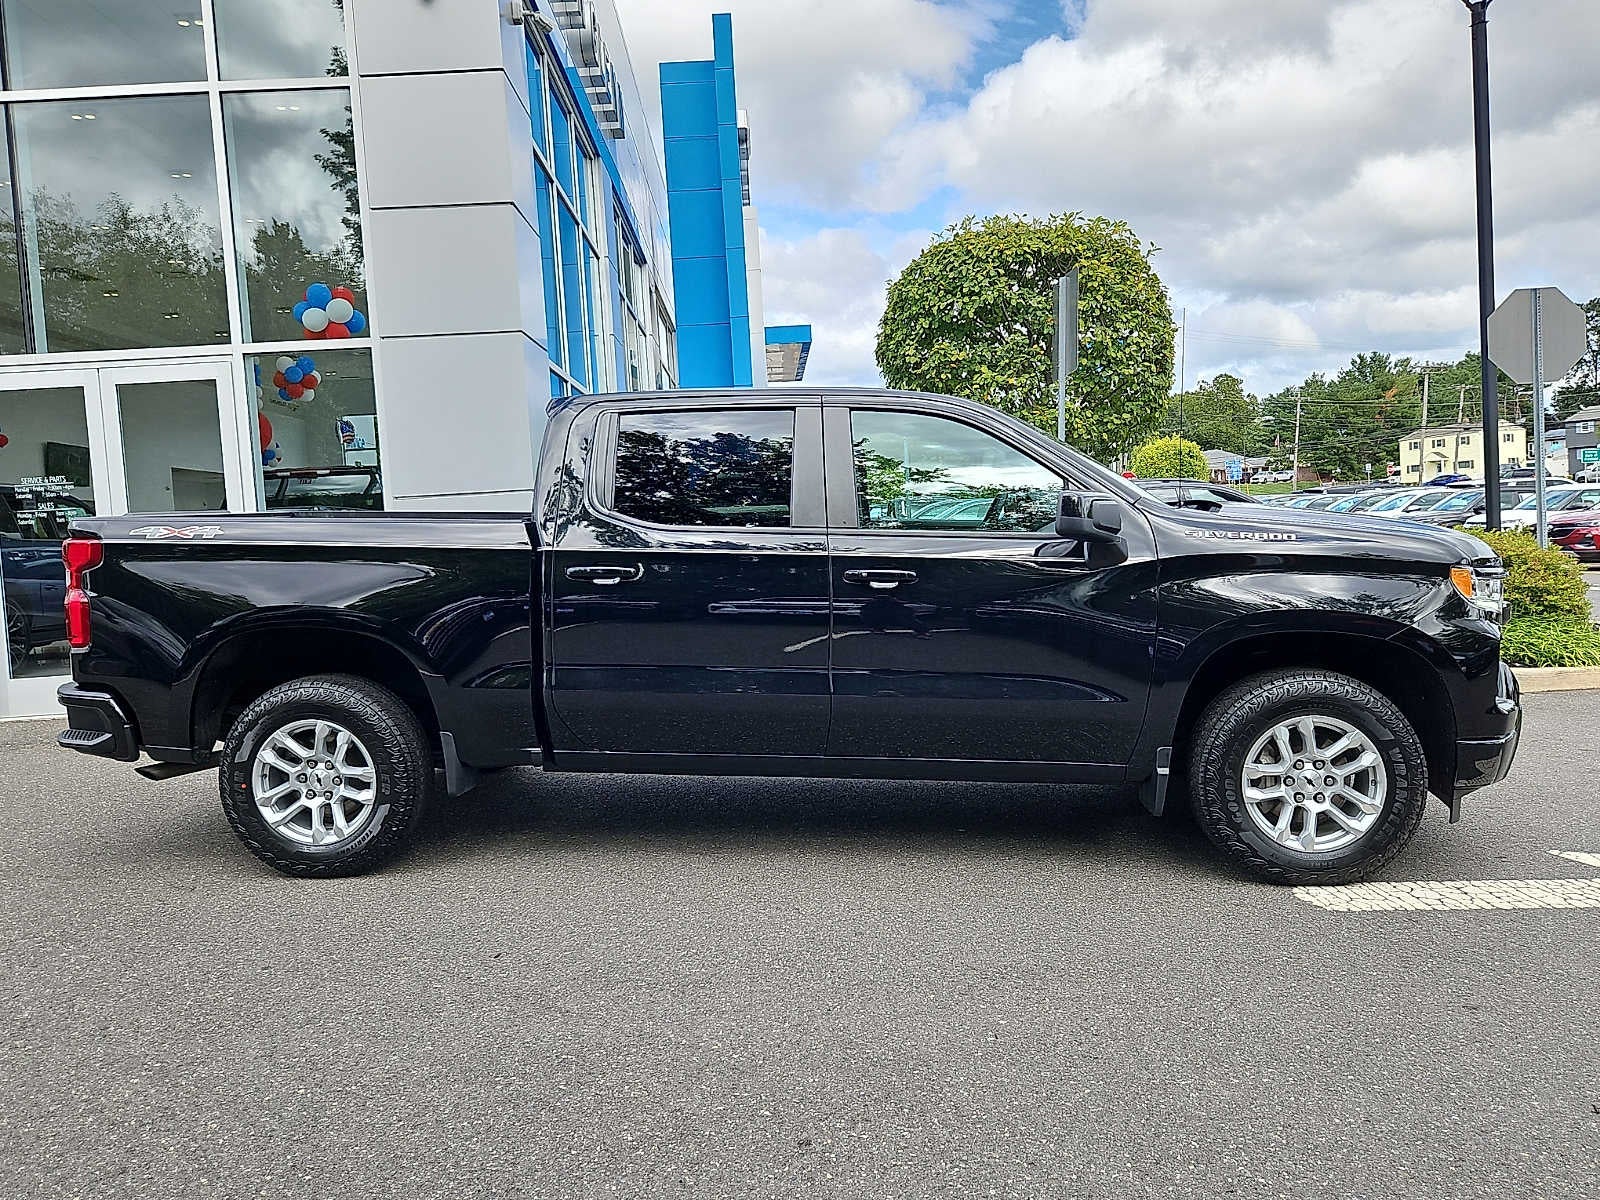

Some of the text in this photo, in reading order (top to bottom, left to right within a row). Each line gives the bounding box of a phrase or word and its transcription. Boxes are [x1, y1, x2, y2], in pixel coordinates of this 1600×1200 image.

[21, 477, 43, 485] SERVICE
[38, 502, 55, 510] SALES
[1184, 528, 1297, 541] SILVERADO
